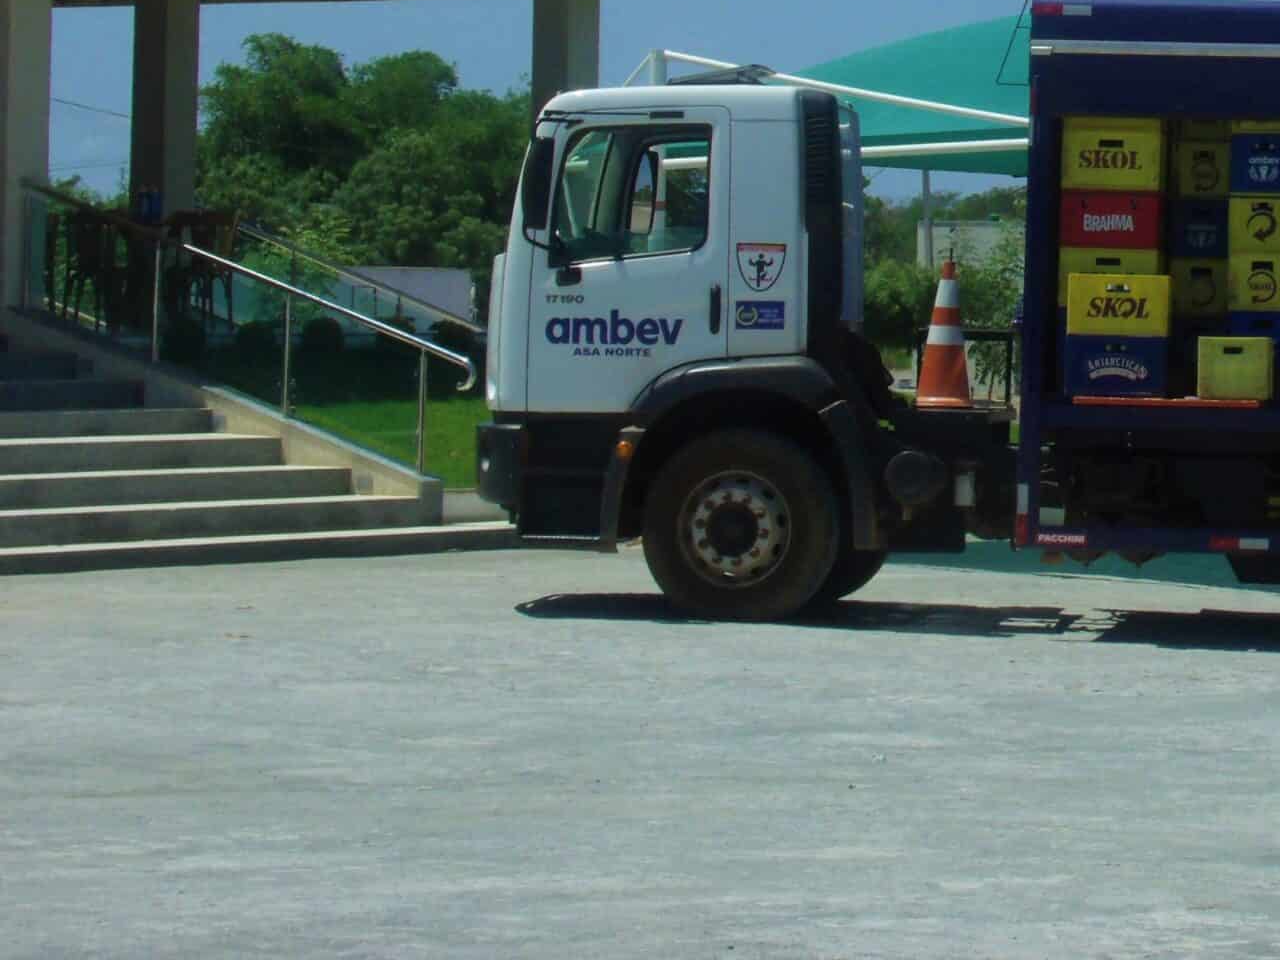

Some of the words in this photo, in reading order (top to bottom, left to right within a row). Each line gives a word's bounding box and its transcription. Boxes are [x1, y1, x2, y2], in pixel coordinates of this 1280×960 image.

[1079, 151, 1142, 170] SKOL
[1083, 213, 1135, 232] BRAHMA
[1087, 296, 1149, 319] SKOL
[546, 309, 684, 345] ambev
[573, 347, 600, 357] ASA
[605, 347, 652, 358] NORTE
